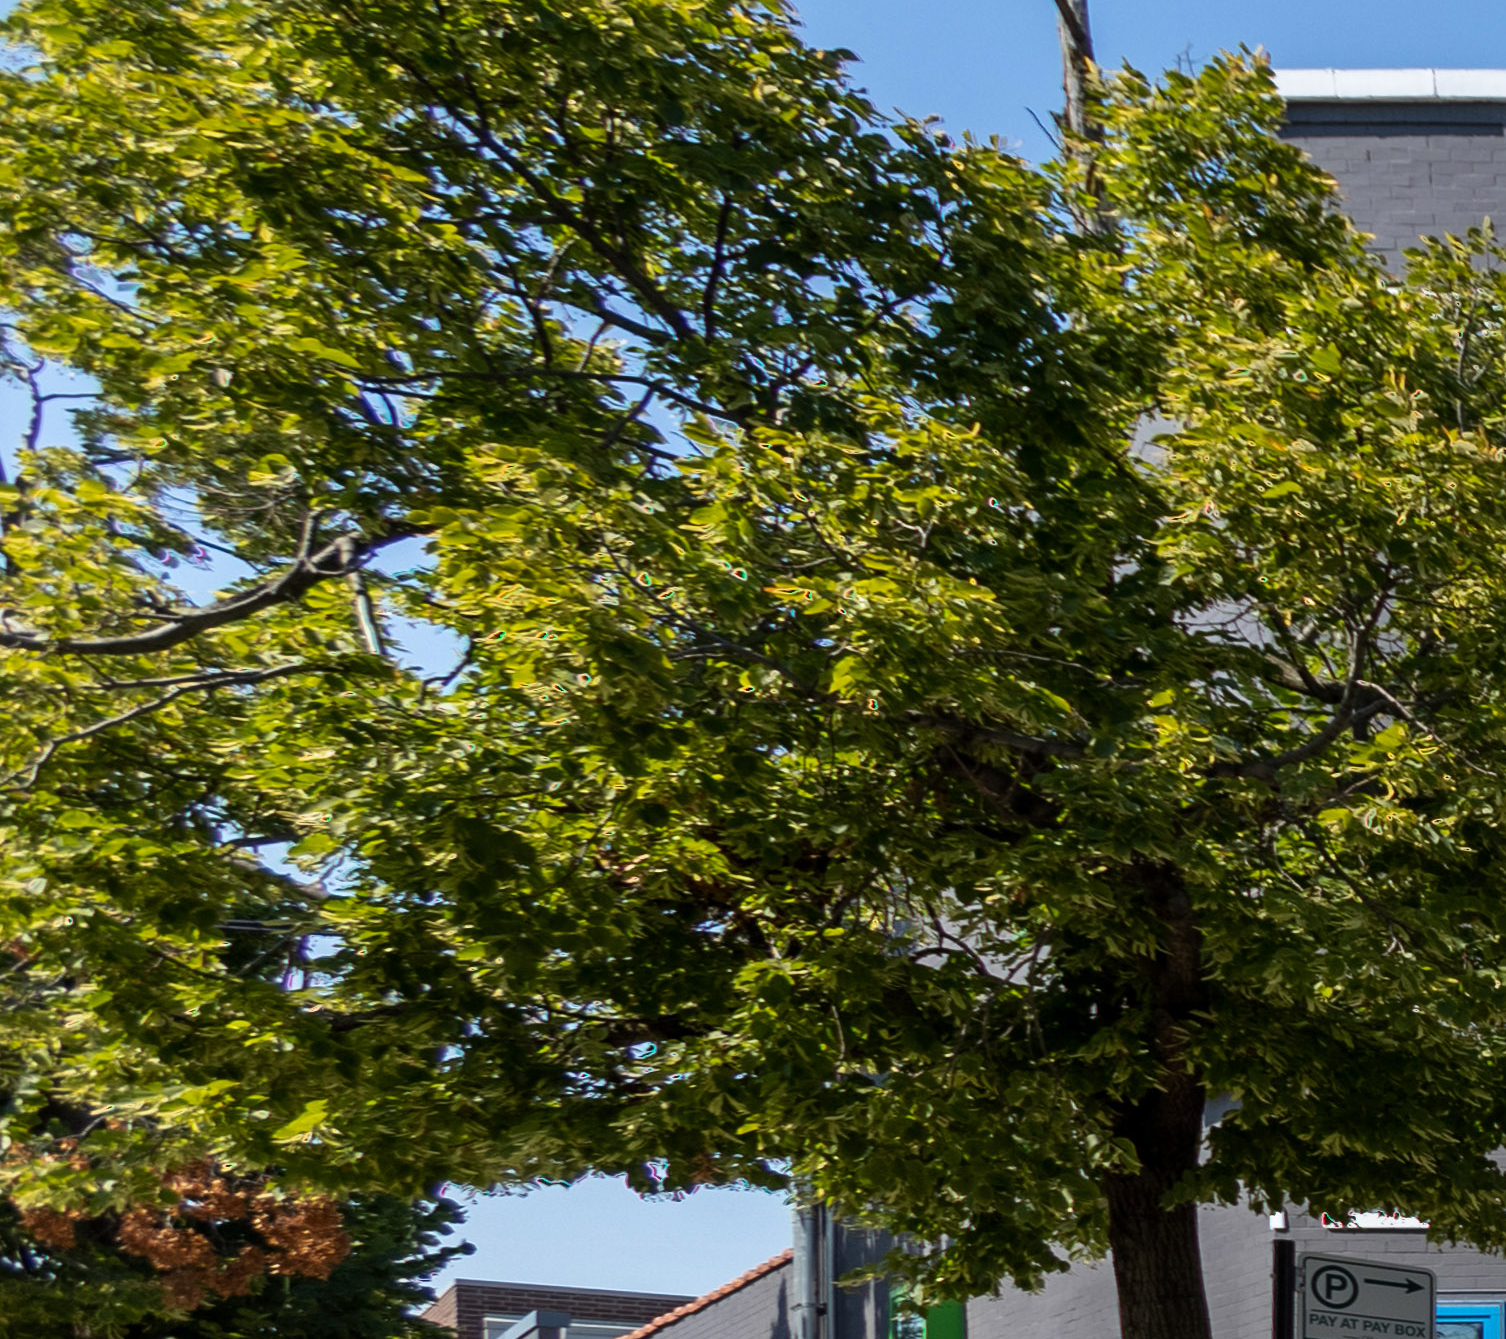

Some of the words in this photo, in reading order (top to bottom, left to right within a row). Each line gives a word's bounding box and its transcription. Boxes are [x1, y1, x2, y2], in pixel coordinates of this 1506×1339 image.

[1309, 1314, 1337, 1327] PAY
[1340, 1317, 1359, 1330] AT
[1362, 1320, 1390, 1334] PAY
[1394, 1324, 1426, 1338] BOX
